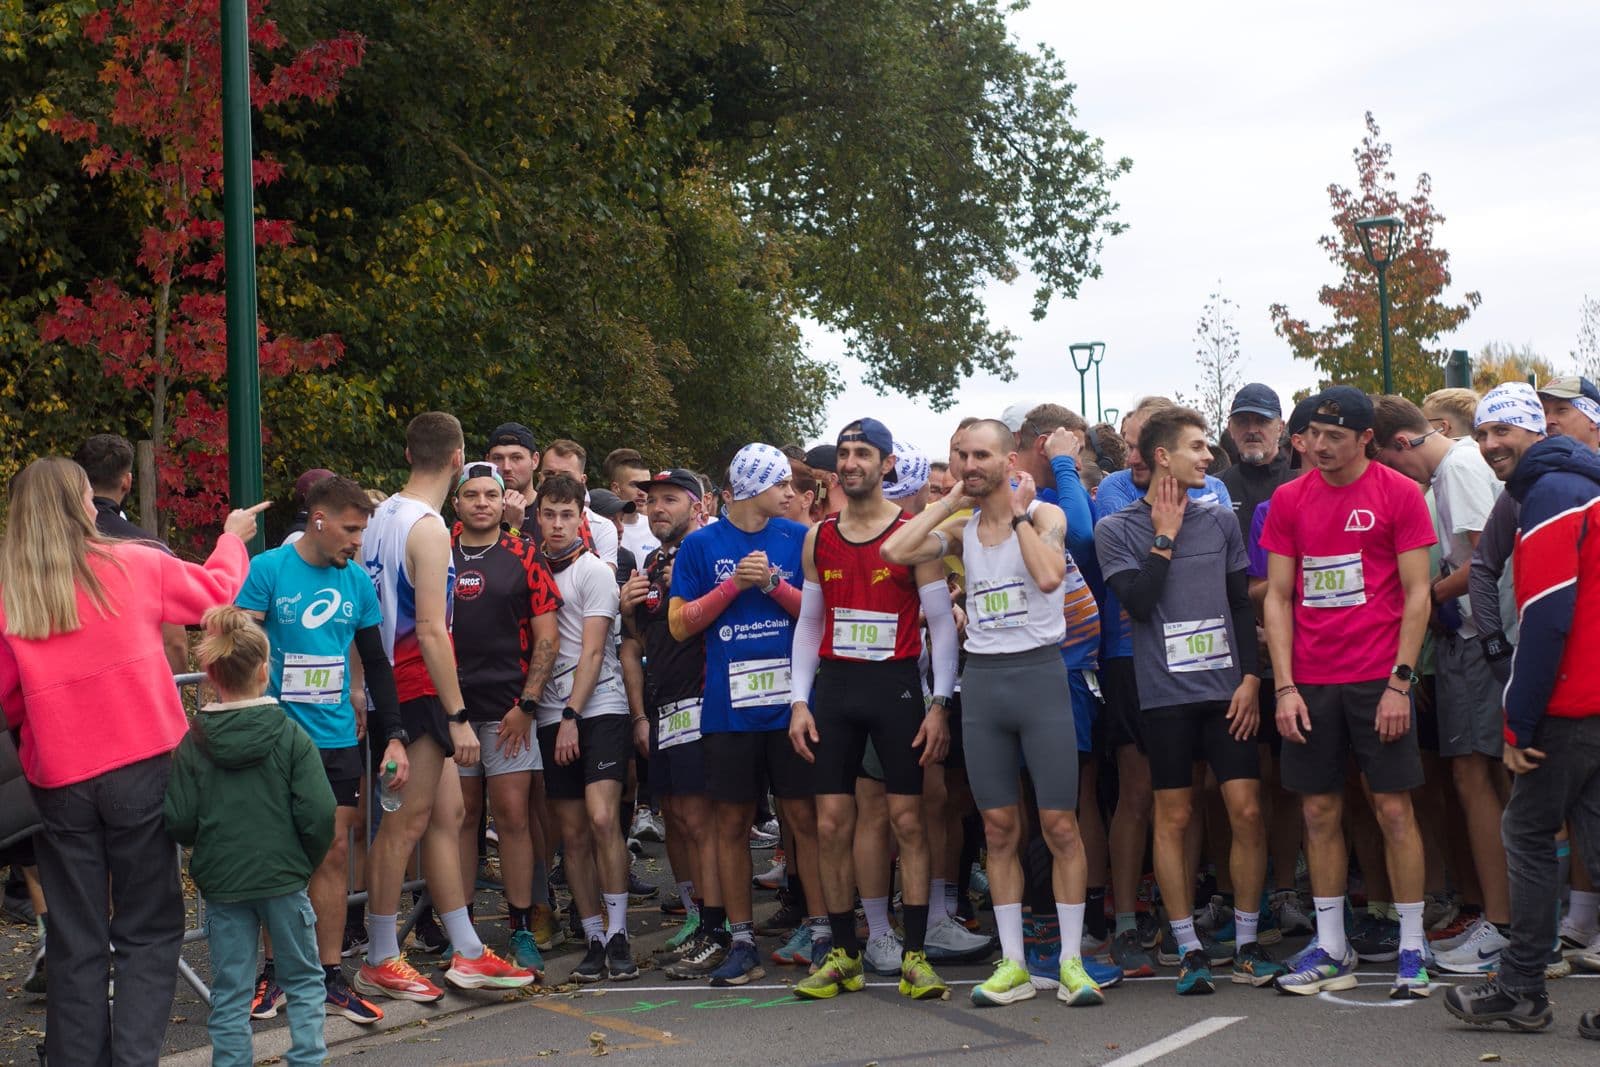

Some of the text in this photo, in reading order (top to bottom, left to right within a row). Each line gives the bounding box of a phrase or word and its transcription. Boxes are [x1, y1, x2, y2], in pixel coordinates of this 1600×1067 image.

[1313, 570, 1345, 591] 287
[850, 624, 878, 644] 119
[1186, 634, 1214, 655] 167
[304, 669, 330, 688] 147
[748, 672, 775, 691] 317
[668, 711, 691, 732] 288
